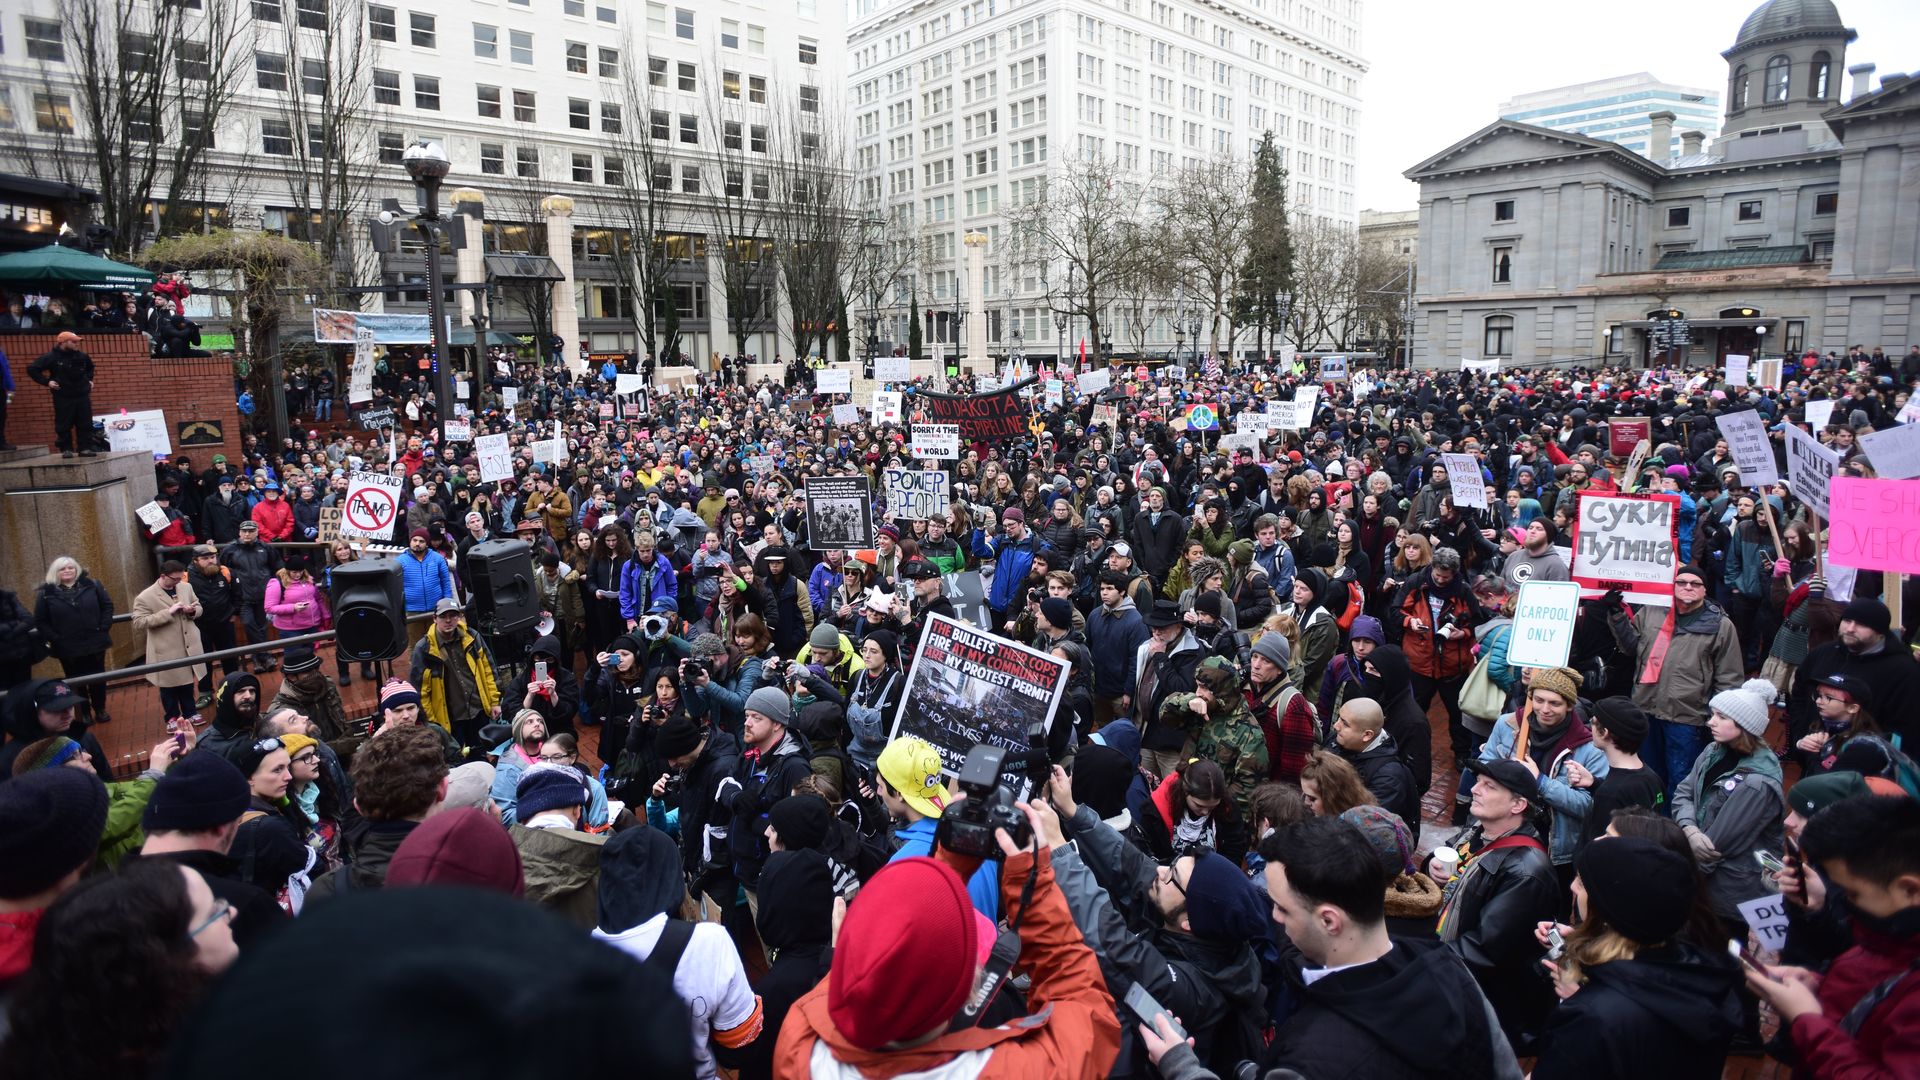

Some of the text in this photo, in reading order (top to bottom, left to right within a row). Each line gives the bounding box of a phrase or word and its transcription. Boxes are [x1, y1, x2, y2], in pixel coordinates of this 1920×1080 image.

[1706, 274, 1756, 282] COURTHOUSE
[354, 365, 366, 376] MAY
[1354, 372, 1366, 386] NO
[360, 406, 394, 420] Unsilenced
[932, 394, 1020, 417] NO DAKOTA
[1297, 401, 1312, 409] NOT
[364, 419, 395, 431] Majority
[974, 415, 1025, 437] PIPELINE
[1744, 433, 1758, 442] Trump
[1798, 438, 1832, 478] UNITE
[351, 471, 402, 487] PORTLAND
[886, 470, 944, 493] POWER
[1454, 485, 1482, 502] GREAT!
[1833, 484, 1867, 512] WE
[352, 499, 392, 517] TRUMP
[896, 490, 948, 519] PEOPLE
[342, 528, 358, 536] NO!
[376, 532, 392, 540] NO!
[1577, 531, 1674, 568] Путина
[1598, 581, 1633, 591] DANGER
[1521, 606, 1569, 621] CARPOOL
[1527, 627, 1556, 642] ONLY
[932, 620, 1058, 676] THE BULLETS THEIR COPS
[928, 633, 1055, 688] FIRE AT MY COMMUNITY
[924, 646, 1052, 703] ARE MY PROTEST PERMIT
[918, 703, 946, 726] BLACK
[948, 722, 984, 742] LIVES
[964, 971, 1000, 1017] Canon
